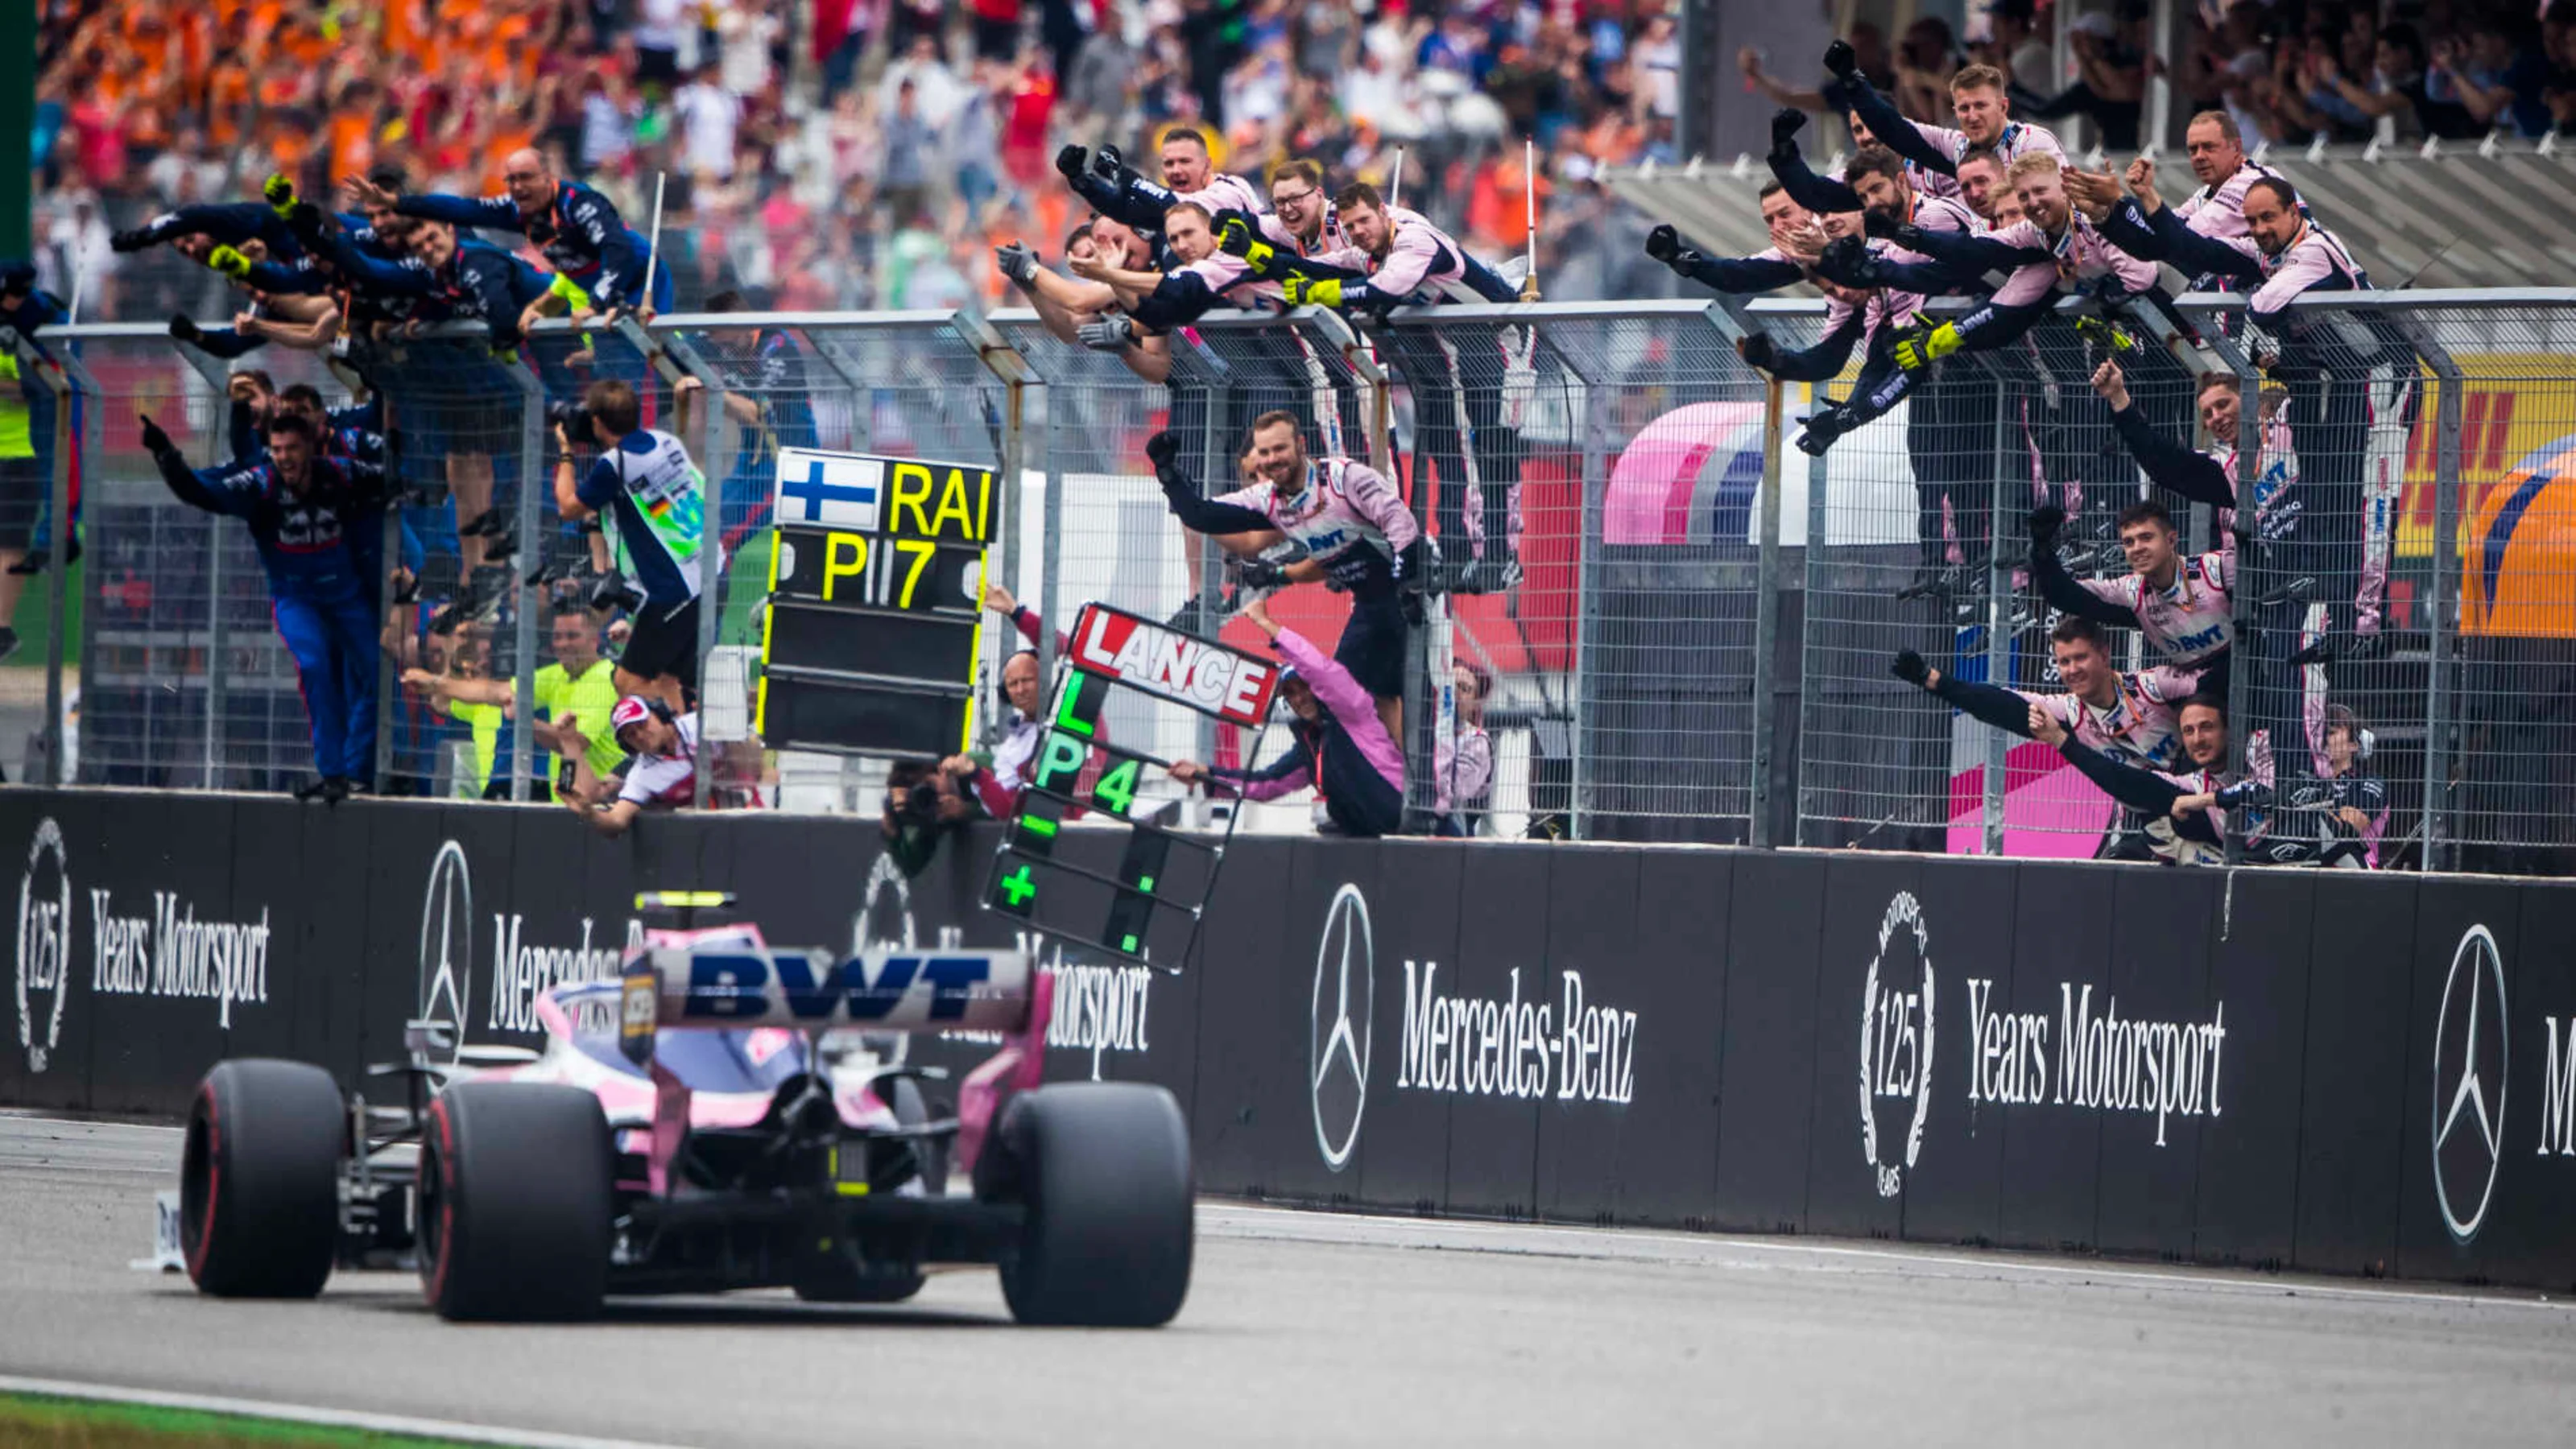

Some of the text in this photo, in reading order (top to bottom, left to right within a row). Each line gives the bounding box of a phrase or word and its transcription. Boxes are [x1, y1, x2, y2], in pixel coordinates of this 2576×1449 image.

[889, 463, 991, 542] RAI
[1082, 609, 1266, 716] LANCE
[2179, 624, 2224, 651] BWT
[29, 901, 59, 989] 125
[91, 889, 271, 1030] Years Motorsport
[684, 955, 989, 1019] BWT
[1397, 960, 1638, 1105] Mercedes-Benz
[1874, 988, 1919, 1097] 125
[1966, 977, 2226, 1148] Years Motorsport
